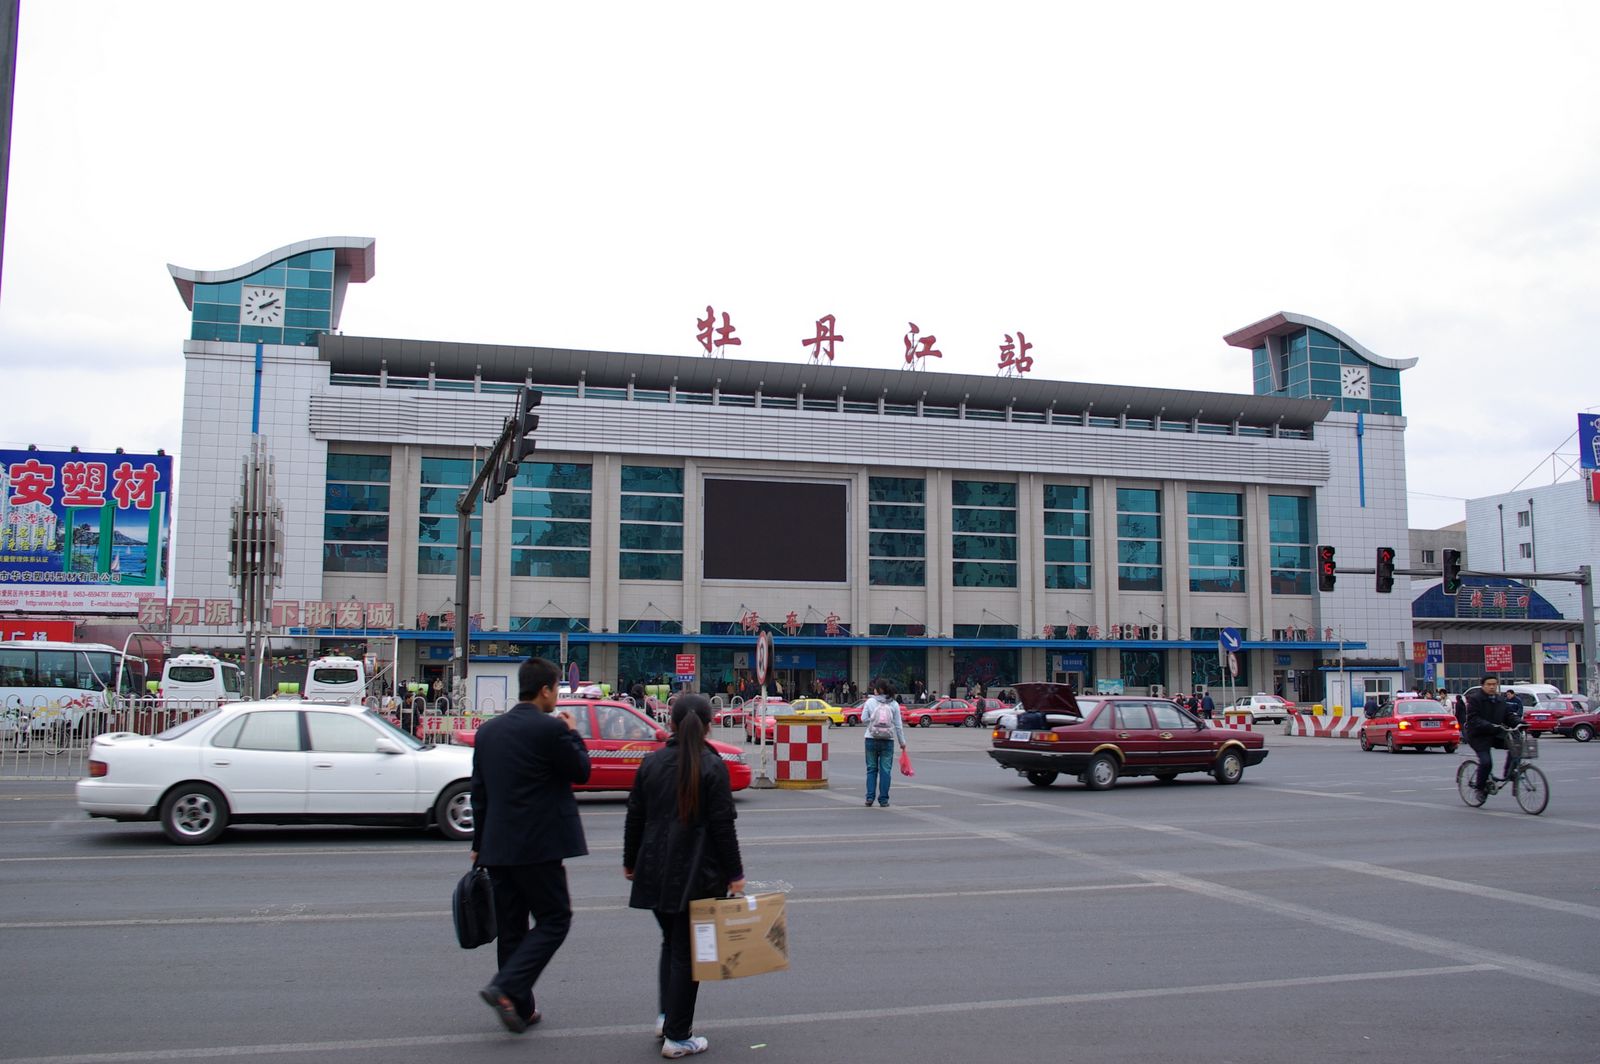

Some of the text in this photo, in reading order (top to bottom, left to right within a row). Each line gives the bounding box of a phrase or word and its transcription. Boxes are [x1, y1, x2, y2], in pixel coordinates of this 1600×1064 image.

[697, 305, 1034, 373] 牡丹江站
[10, 459, 160, 509] 安塑材
[0, 539, 57, 551] 免检产品
[0, 570, 121, 582] 市华安塑料型材有限公司
[139, 599, 393, 629] 东方源下批发城
[740, 611, 841, 634] 候车室
[0, 631, 47, 641] 广场
